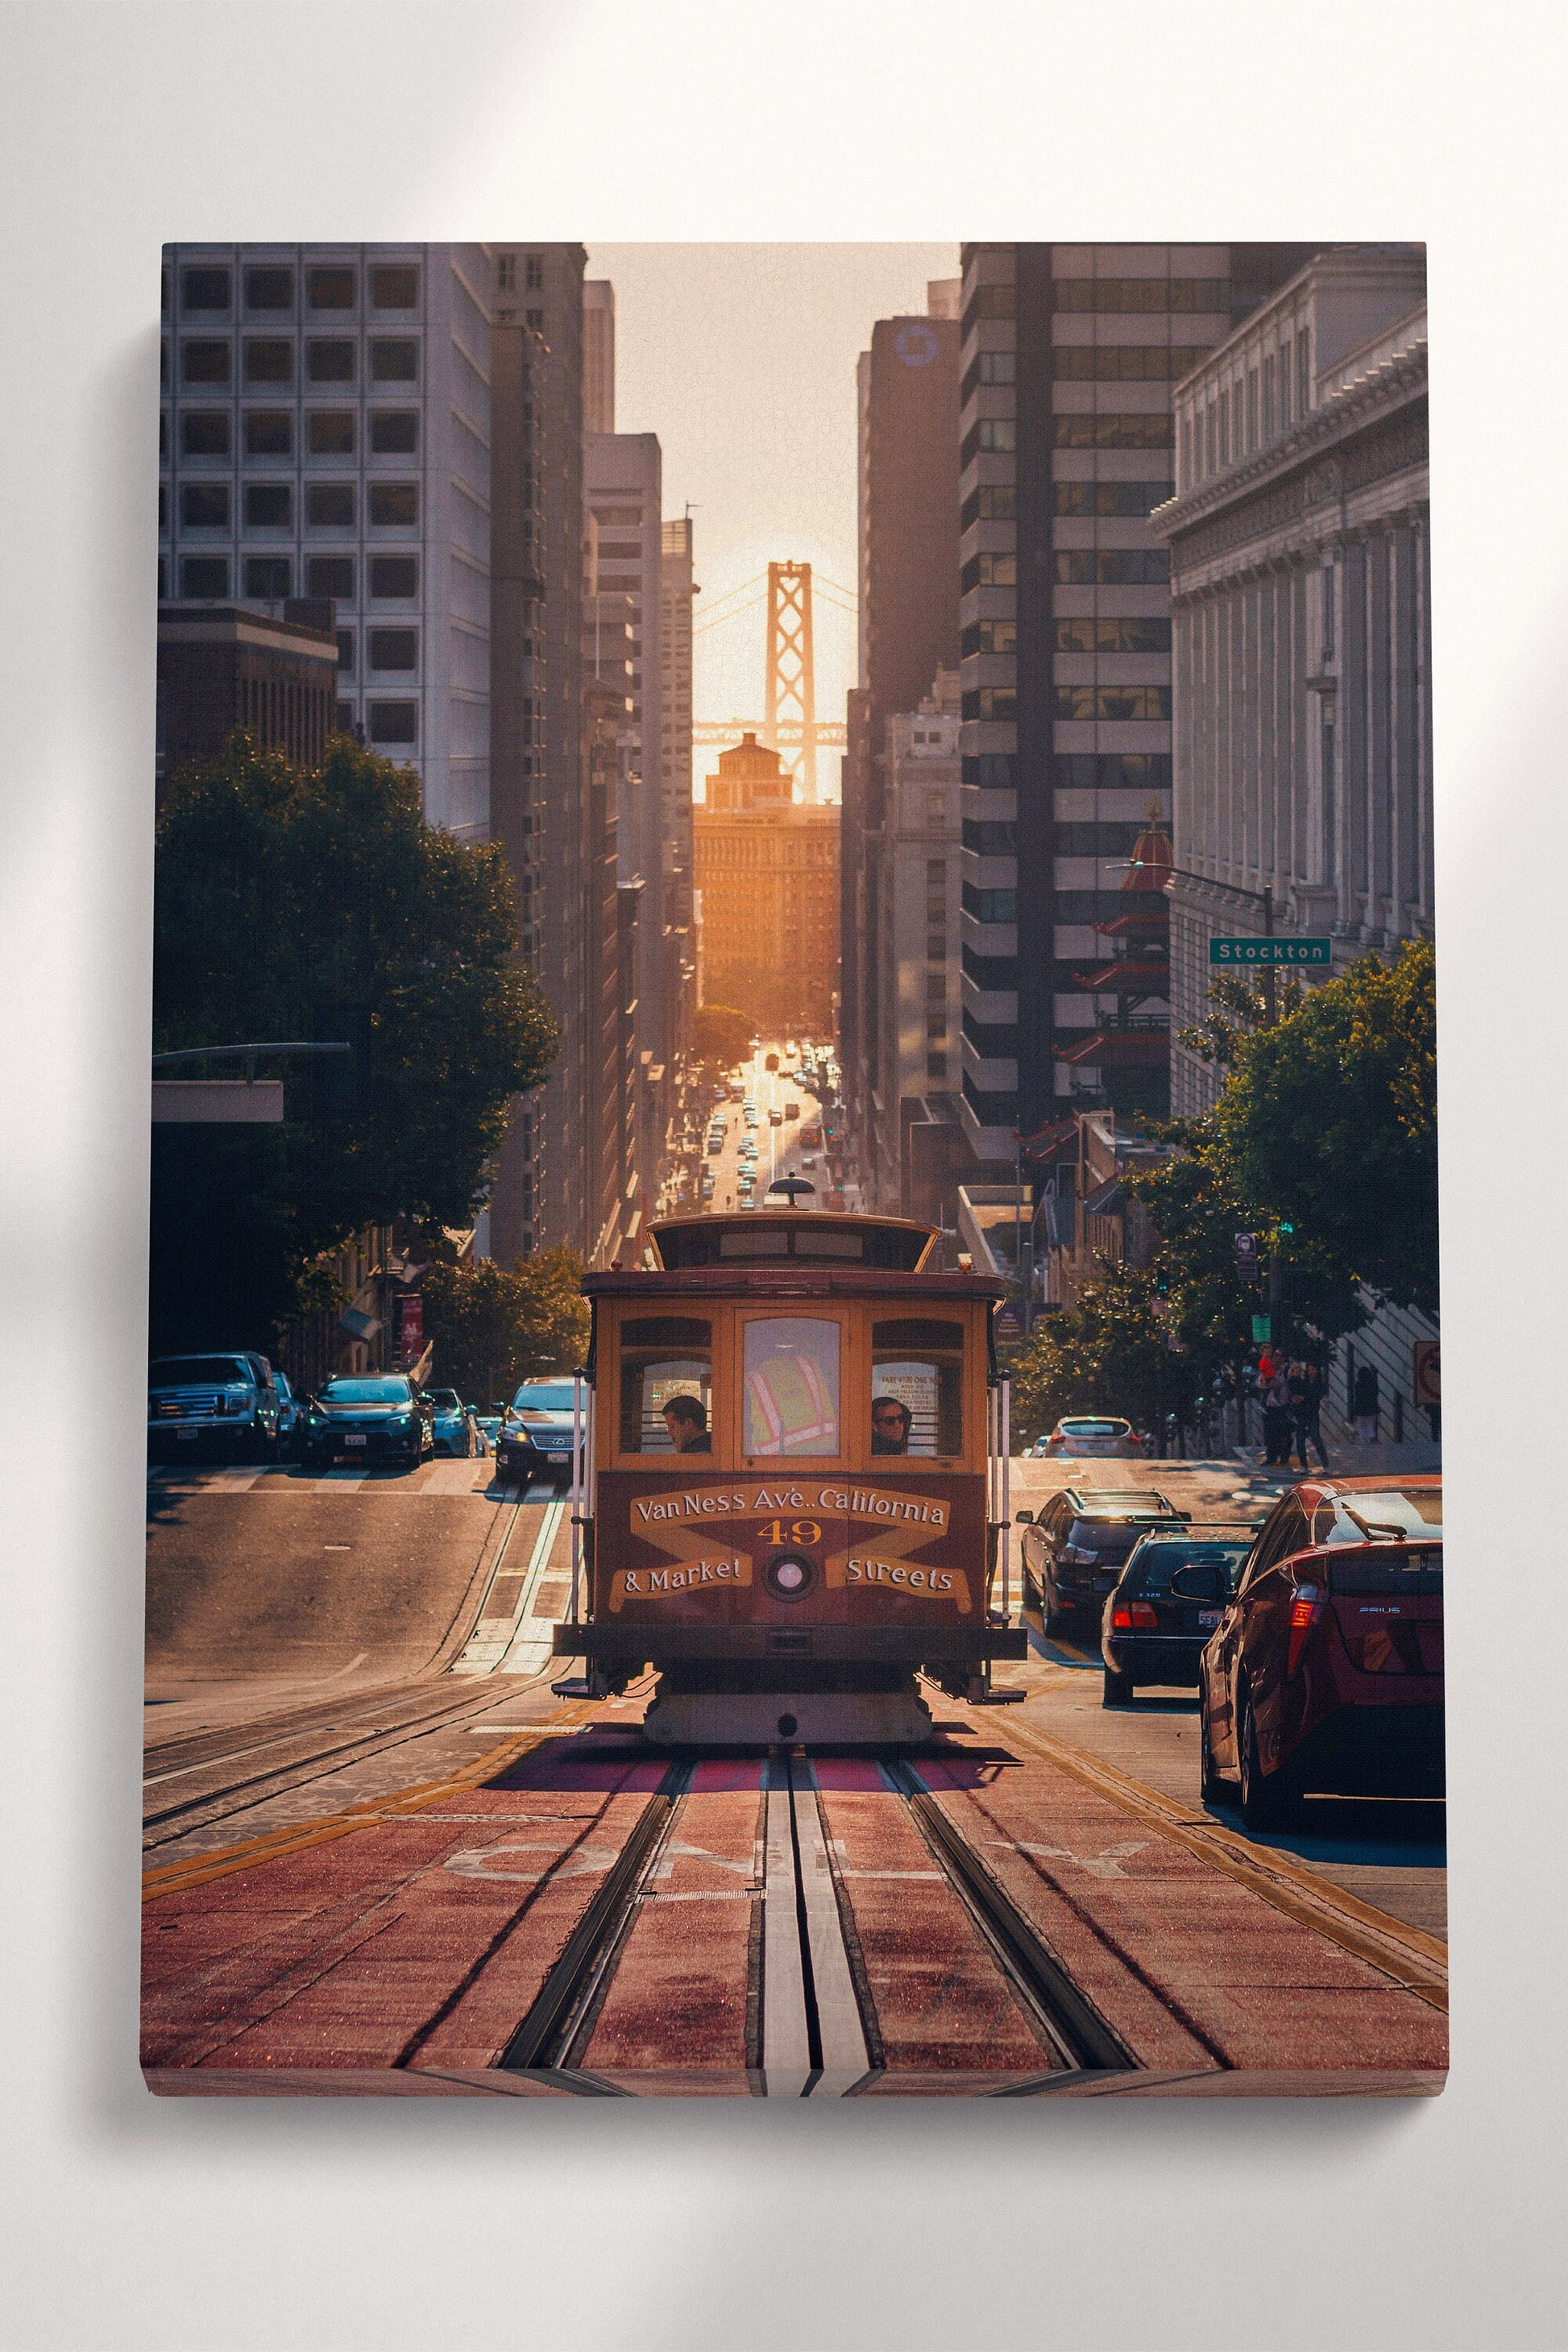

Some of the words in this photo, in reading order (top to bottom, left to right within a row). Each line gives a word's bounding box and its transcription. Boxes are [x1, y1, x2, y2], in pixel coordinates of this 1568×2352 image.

[1219, 944, 1322, 959] Stockton
[637, 1500, 680, 1522] Van
[682, 1494, 745, 1516] Ness
[819, 1489, 944, 1525] California
[757, 1520, 821, 1545] 49
[625, 1571, 642, 1592] &
[649, 1558, 740, 1591] Market
[848, 1559, 952, 1591] Streets
[442, 1840, 1154, 1883] ONLY
